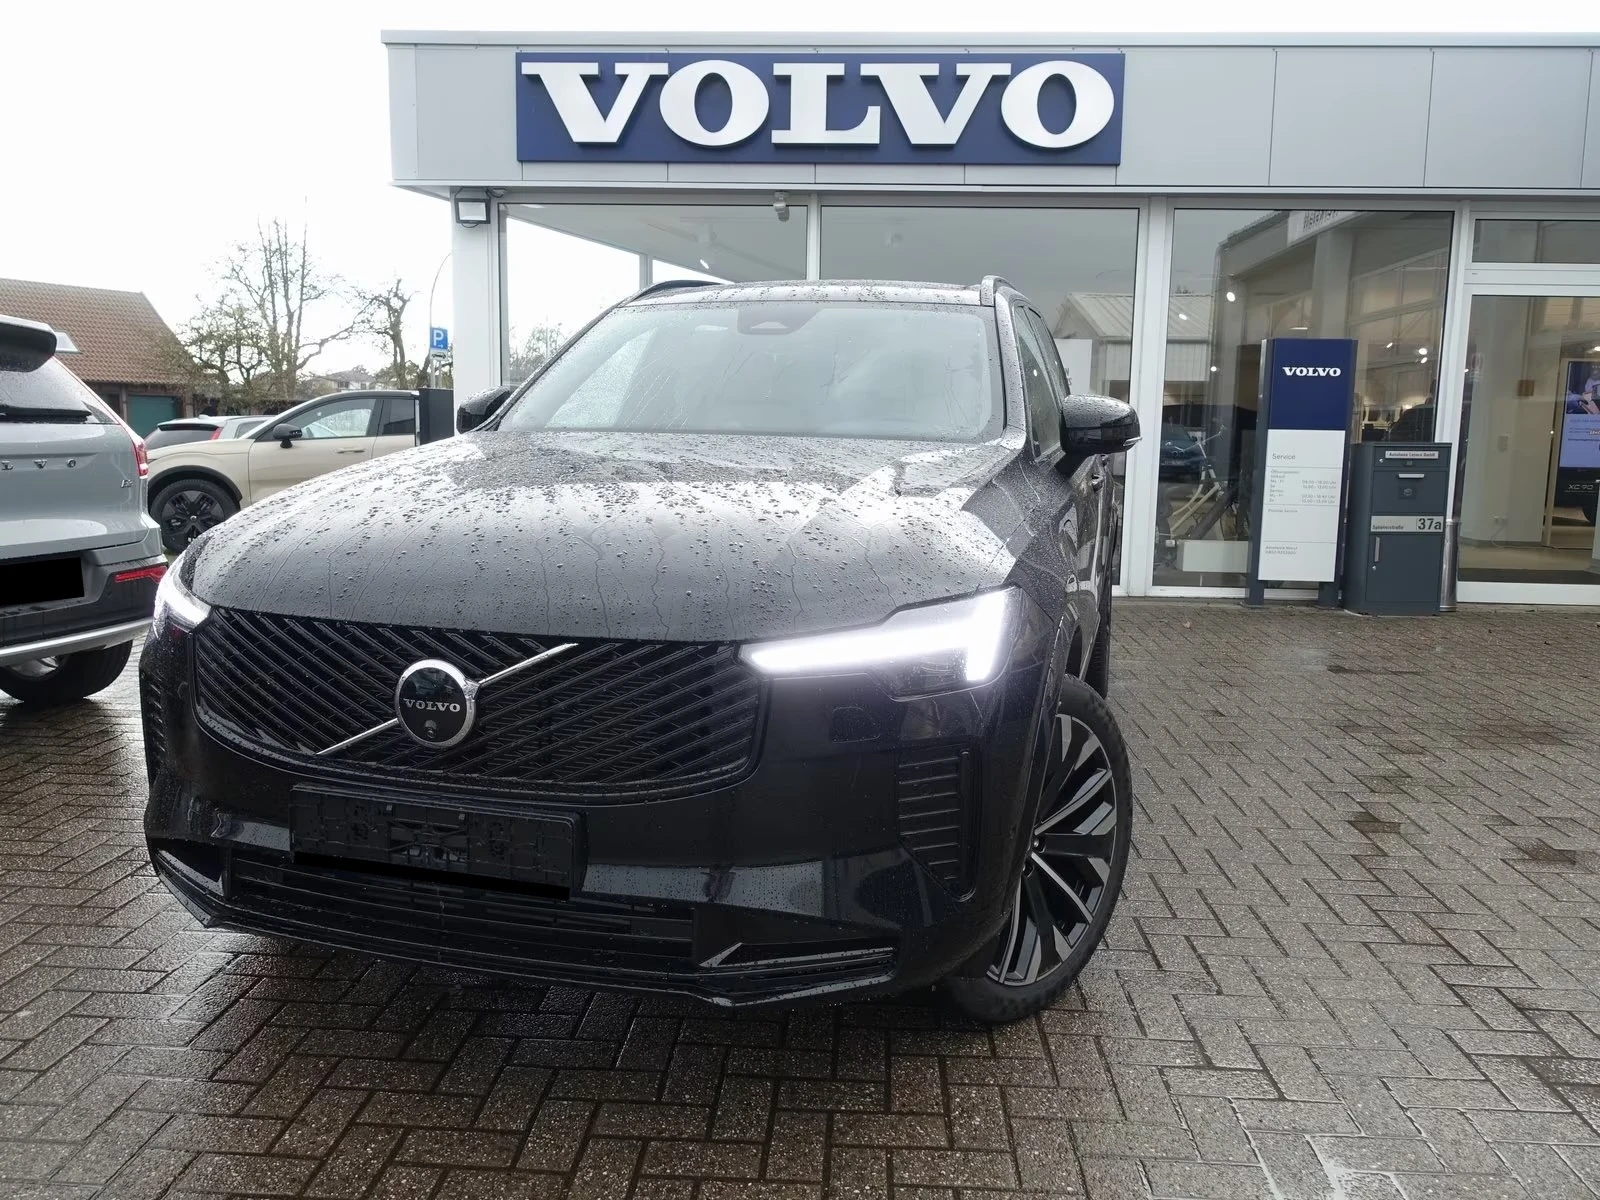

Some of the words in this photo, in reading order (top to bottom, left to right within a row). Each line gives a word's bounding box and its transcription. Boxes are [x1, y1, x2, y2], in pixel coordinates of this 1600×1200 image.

[521, 60, 1114, 148] VOLVO
[433, 329, 444, 346] P
[1282, 366, 1341, 377] VOLVO
[1418, 518, 1442, 530] 37a
[403, 698, 461, 713] VOLVO
